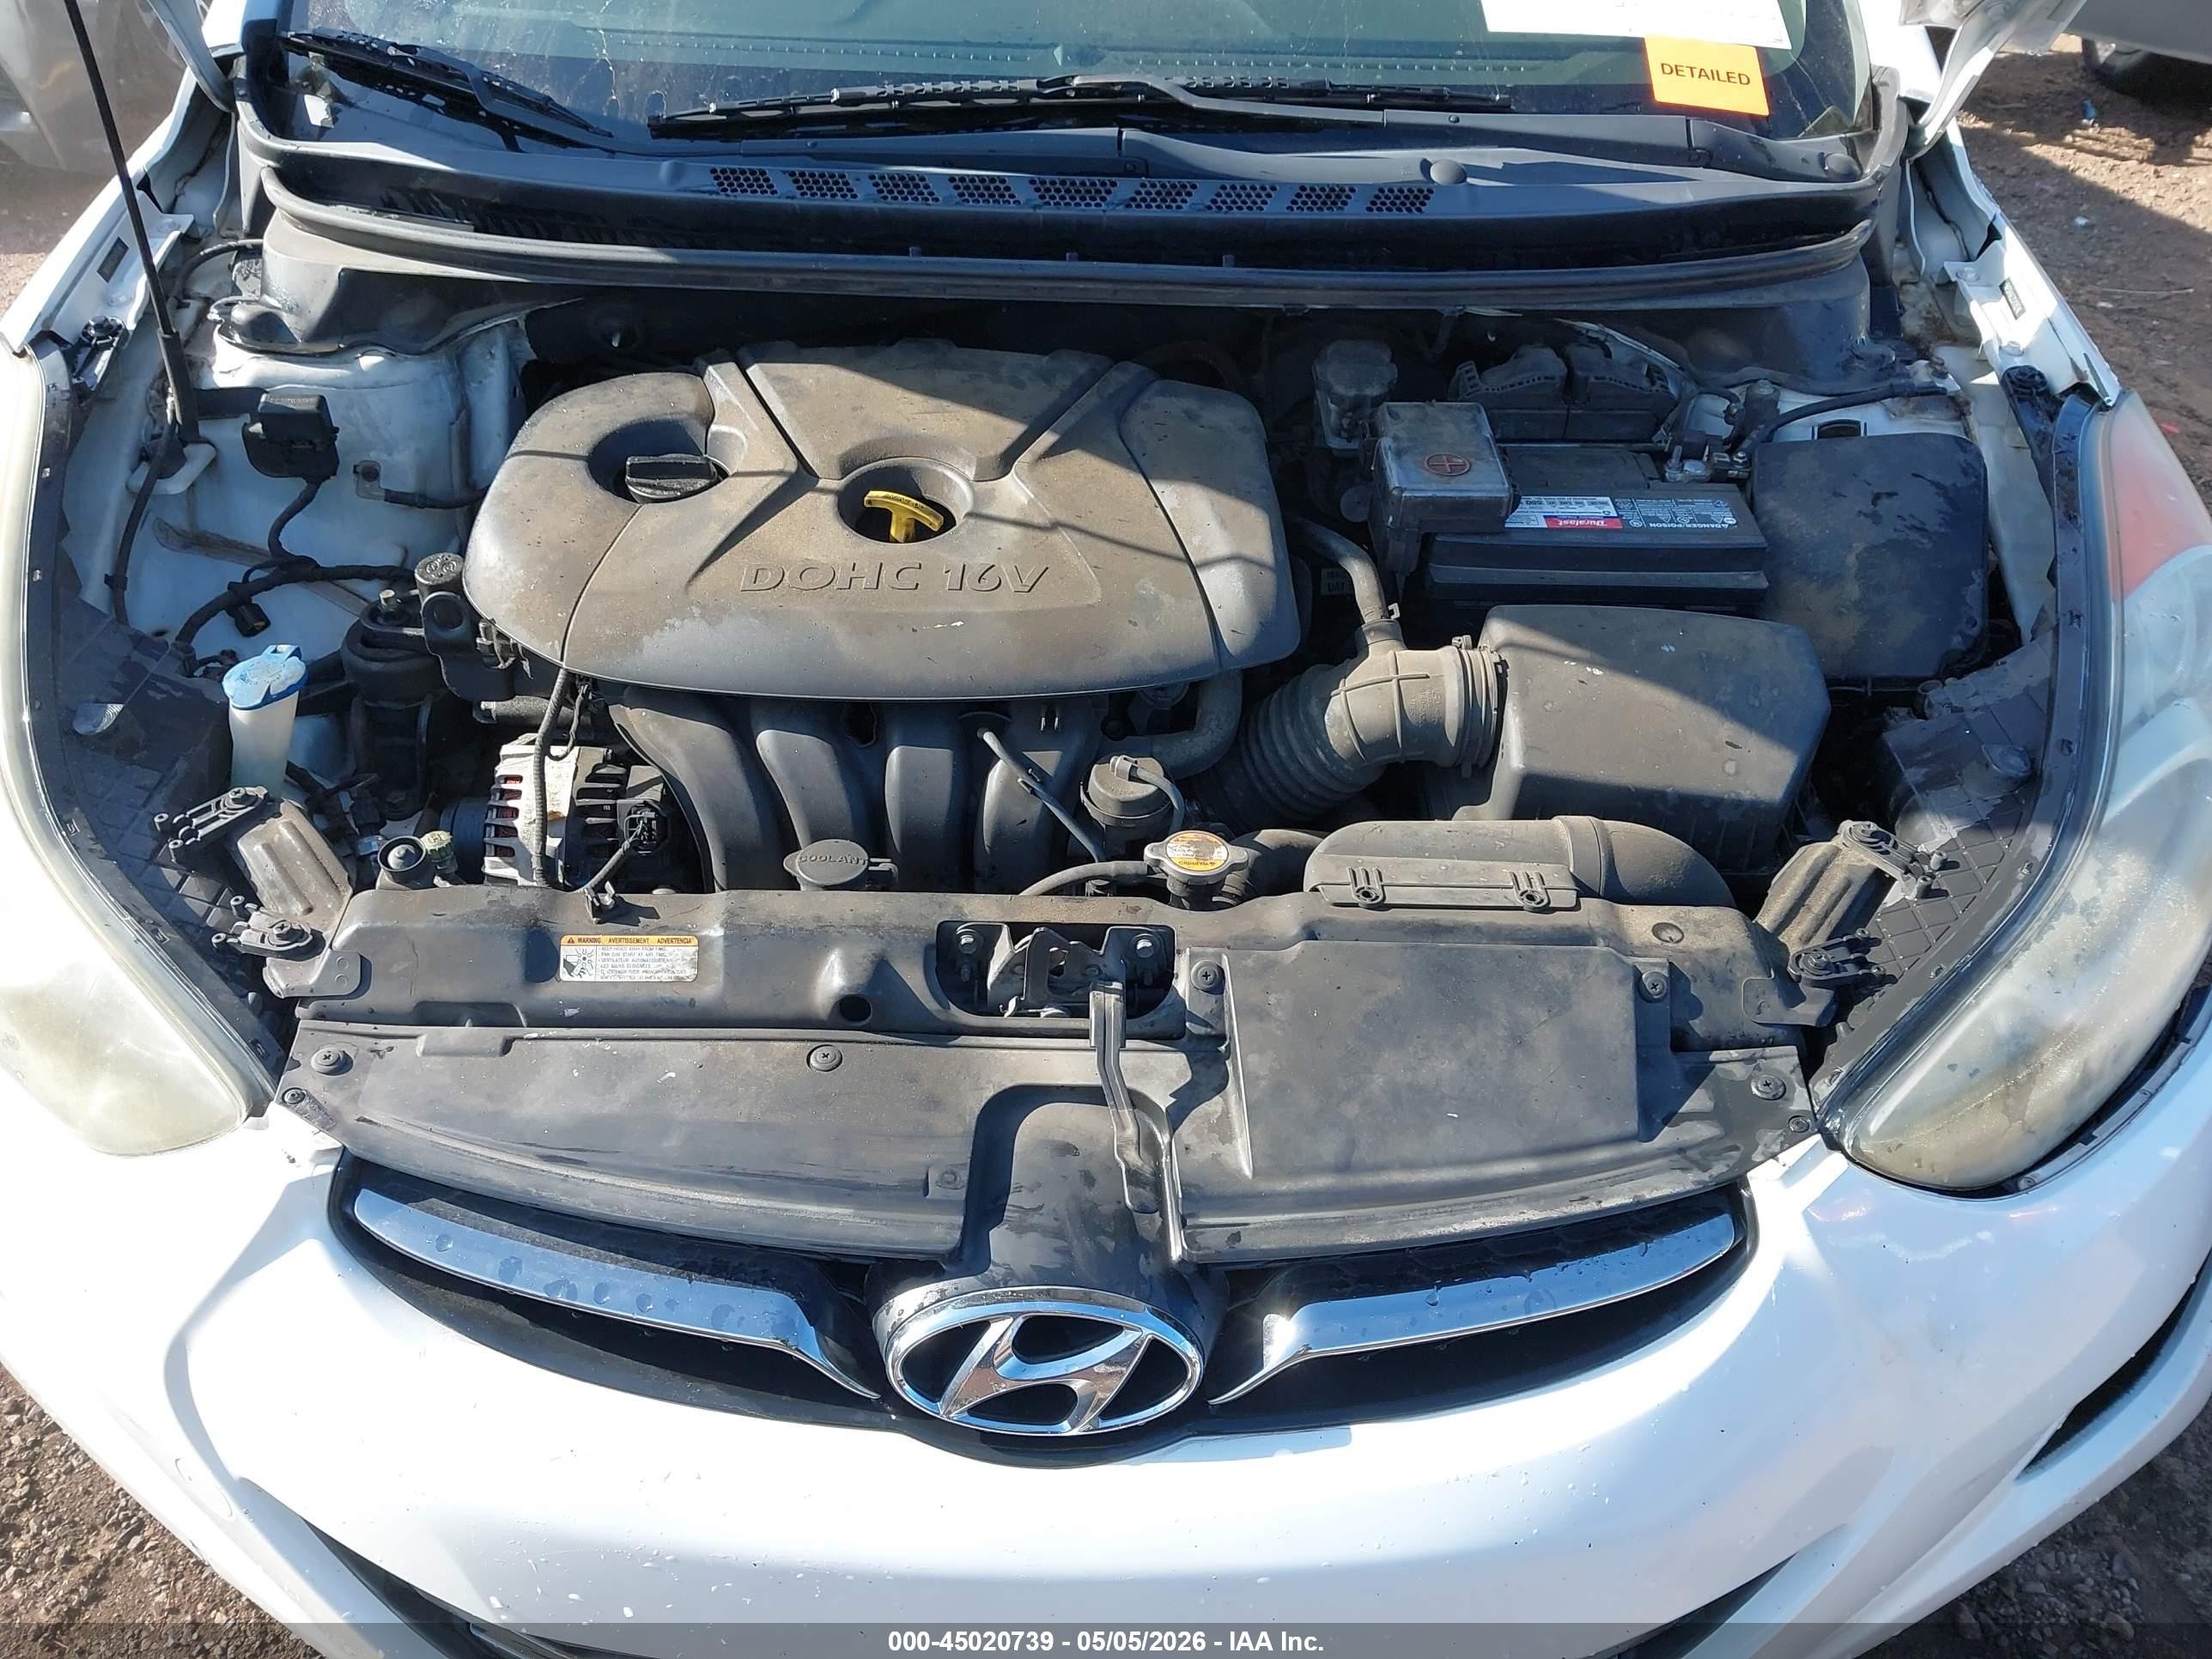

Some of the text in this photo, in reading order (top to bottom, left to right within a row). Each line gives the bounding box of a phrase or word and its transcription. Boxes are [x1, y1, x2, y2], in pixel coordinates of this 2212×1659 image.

[1661, 63, 1751, 87] DETAILED
[739, 562, 1049, 594] DOHC 16V
[799, 854, 866, 866] COOLANT
